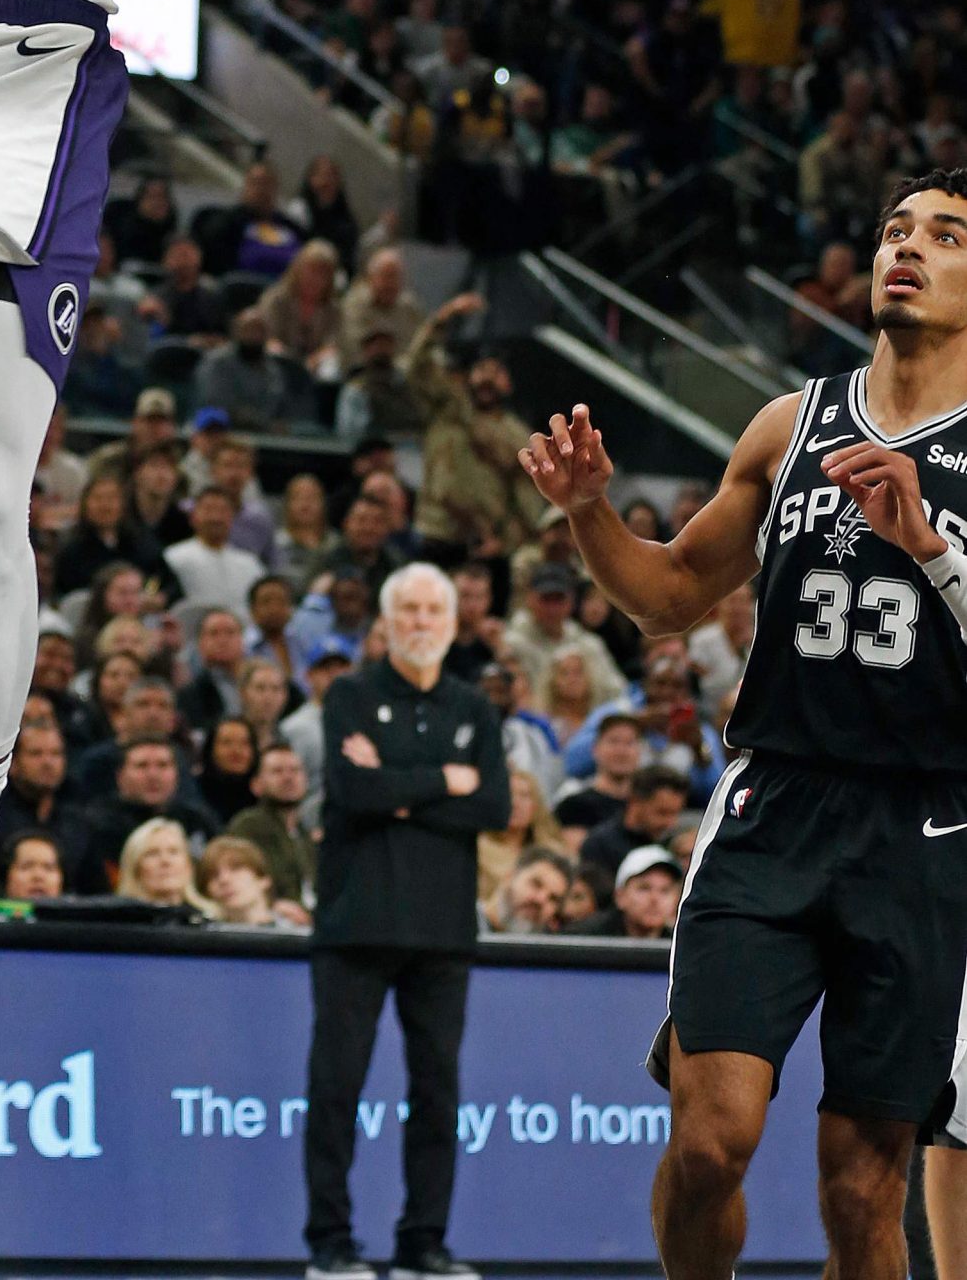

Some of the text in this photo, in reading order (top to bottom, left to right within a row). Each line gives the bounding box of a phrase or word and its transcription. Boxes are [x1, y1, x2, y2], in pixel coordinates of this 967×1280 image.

[821, 404, 840, 425] 6
[794, 568, 921, 670] 33
[171, 1085, 267, 1139] The
[280, 1096, 387, 1140] nw
[506, 1094, 560, 1144] to
